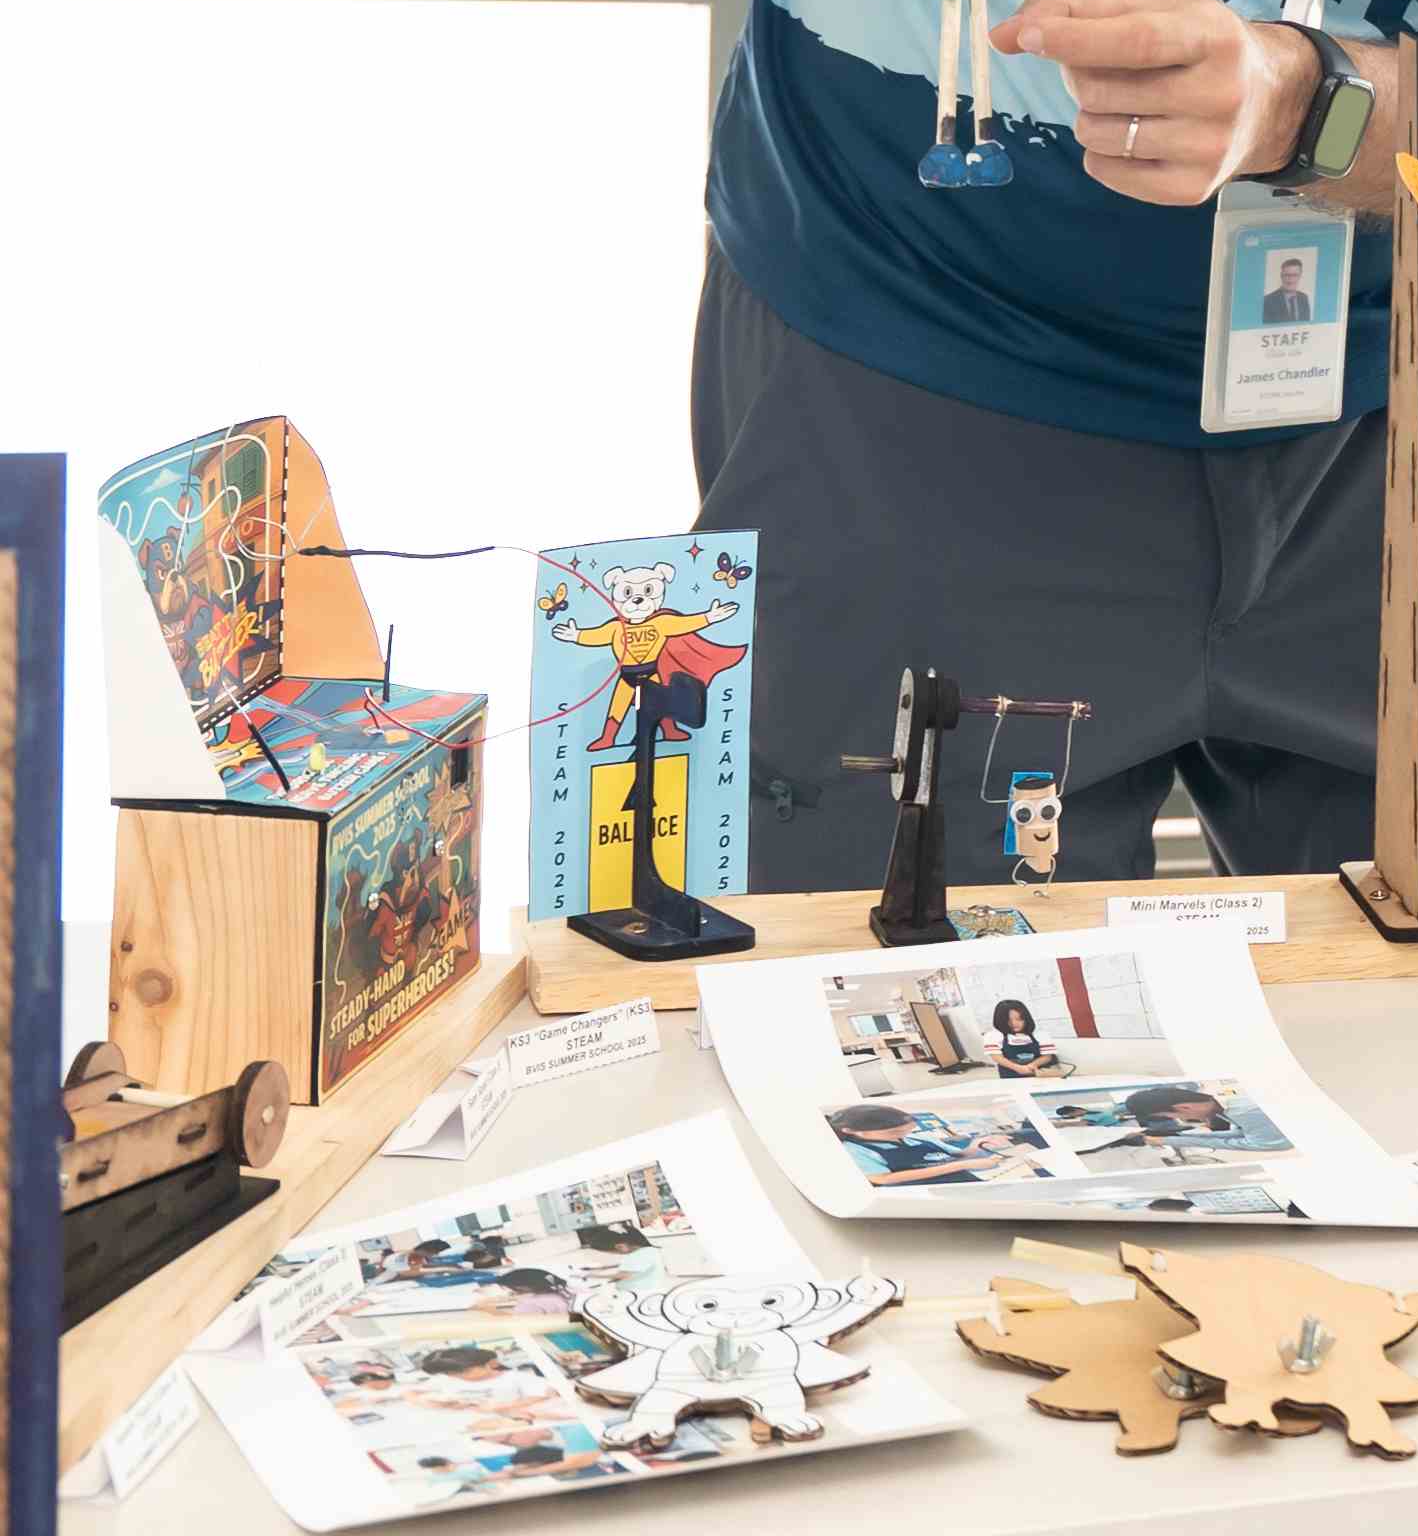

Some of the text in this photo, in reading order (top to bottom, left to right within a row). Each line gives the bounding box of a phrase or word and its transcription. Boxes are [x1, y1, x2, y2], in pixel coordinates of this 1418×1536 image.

[1260, 331, 1310, 348] STAFF
[1237, 366, 1331, 385] James Chandler
[624, 629, 657, 644] BVIS
[718, 687, 735, 891] STEAM 2025
[553, 702, 569, 910] STEAM 2025
[598, 814, 679, 847] BALCE
[1130, 896, 1263, 911] Mini Marvels (Class 2)
[1247, 926, 1269, 936] 2025
[329, 959, 406, 1040] STEADY-HAND
[347, 949, 455, 1051] FOR SUPERHEROES!
[510, 1035, 531, 1050] KS3
[566, 1031, 603, 1052] STEAM
[525, 1034, 648, 1076] BVIS SUMMER SCHOOL 2025
